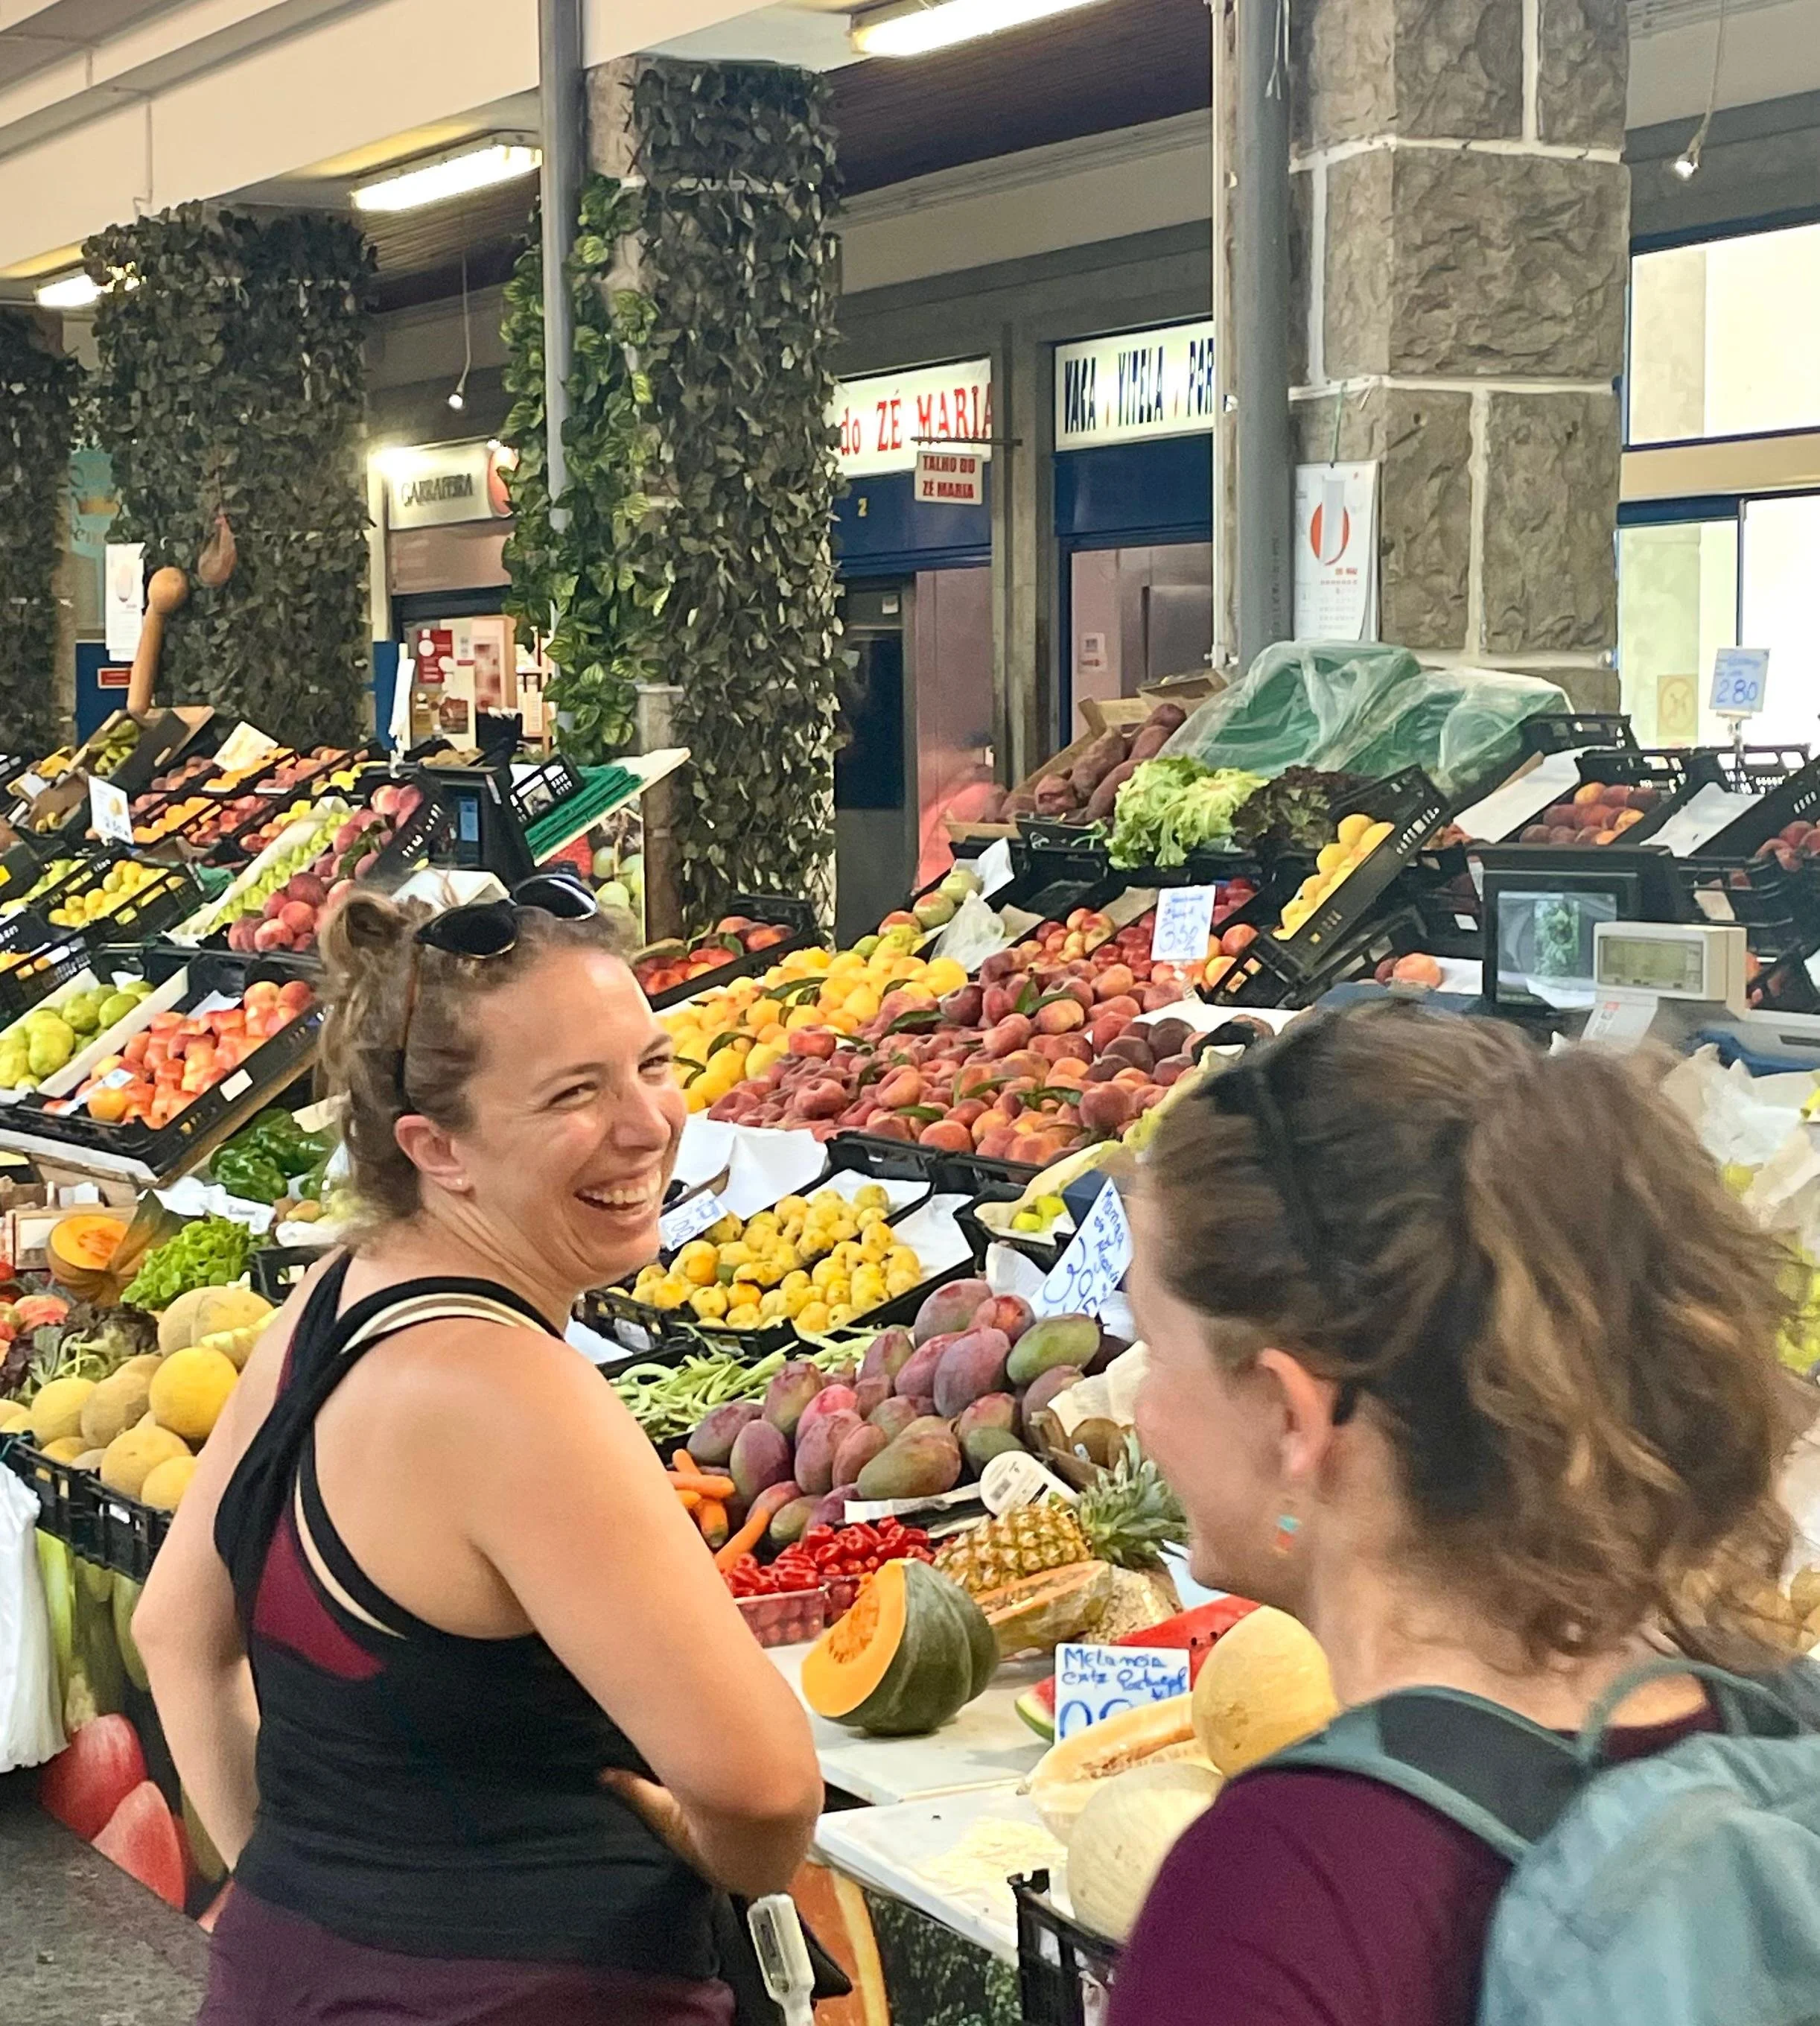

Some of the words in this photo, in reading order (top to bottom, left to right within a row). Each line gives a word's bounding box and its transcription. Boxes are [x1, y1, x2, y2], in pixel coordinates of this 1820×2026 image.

[840, 407, 861, 455] do
[877, 389, 903, 451] ZÉ
[923, 455, 957, 472] TALHO
[960, 457, 976, 474] DO
[923, 478, 934, 496] ZÉ
[937, 482, 974, 498] MARIA
[858, 498, 868, 517] 2
